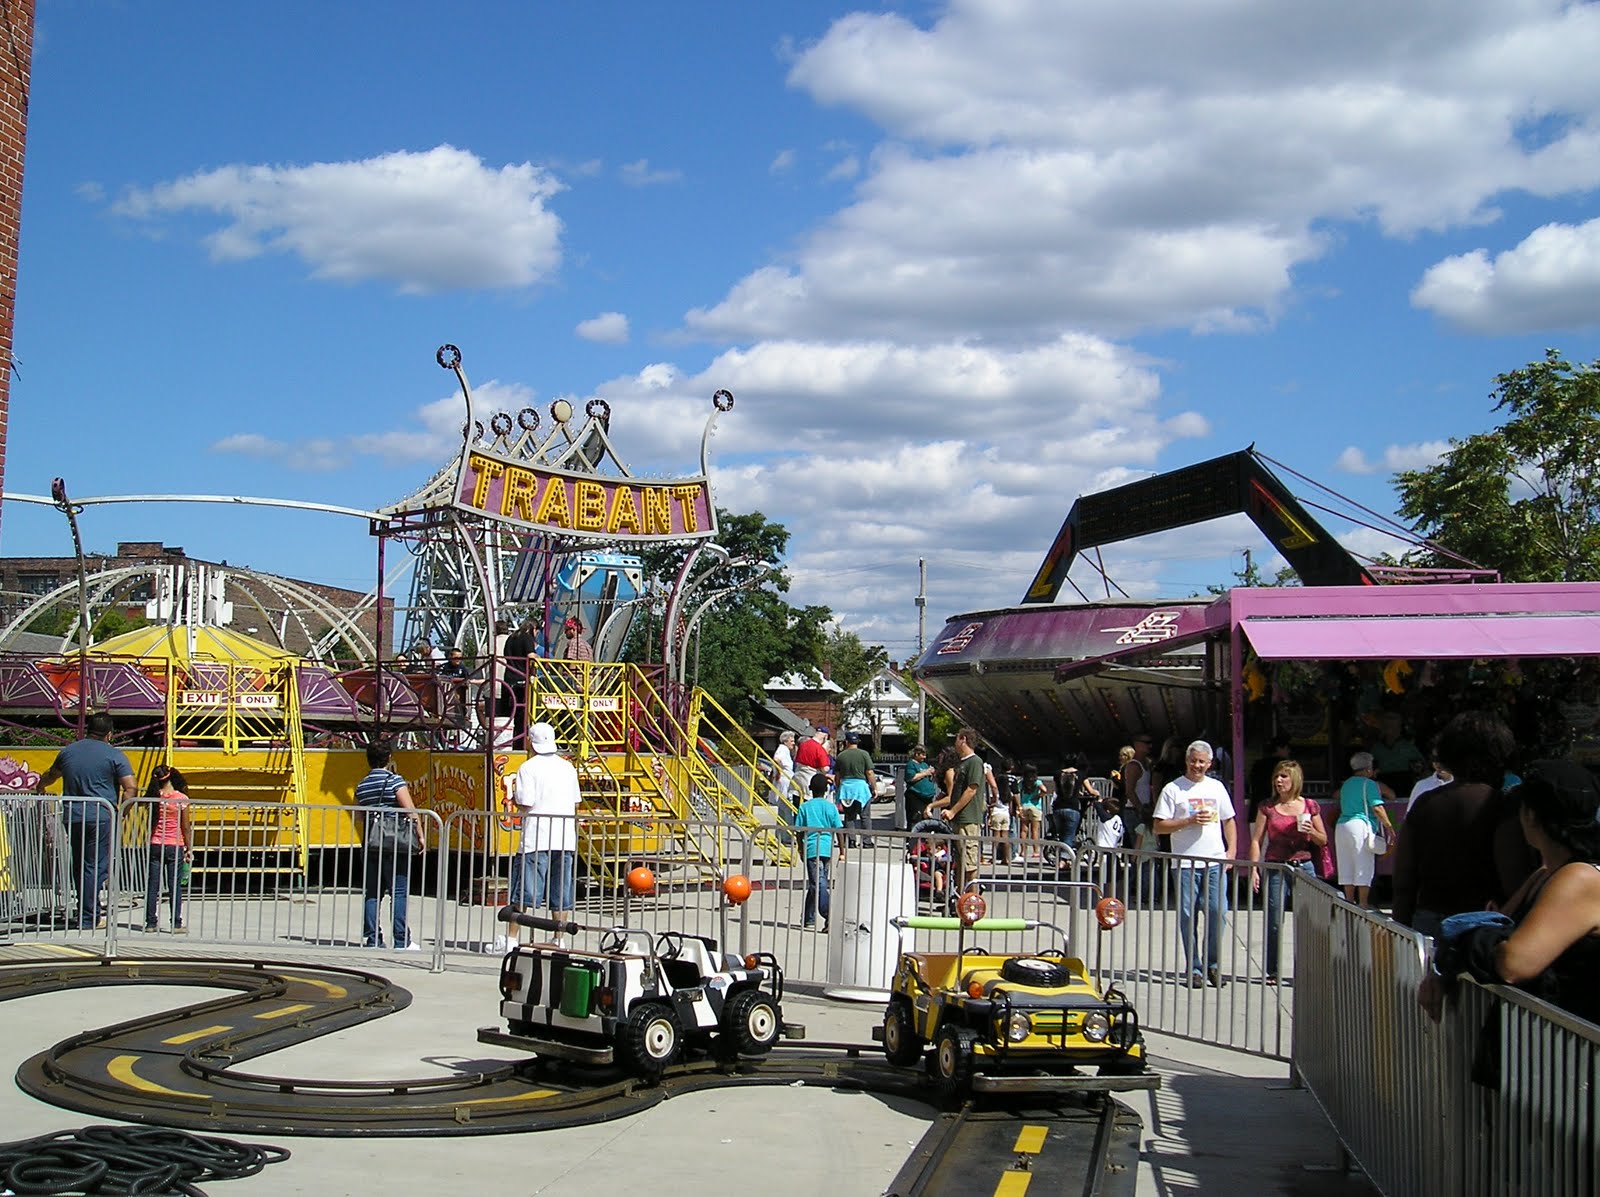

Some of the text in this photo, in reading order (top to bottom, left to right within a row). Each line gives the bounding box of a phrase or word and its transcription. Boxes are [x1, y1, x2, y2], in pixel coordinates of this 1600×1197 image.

[470, 455, 701, 534] TRABANT
[187, 693, 274, 704] EXIT ONLY
[593, 699, 613, 707] ONLY
